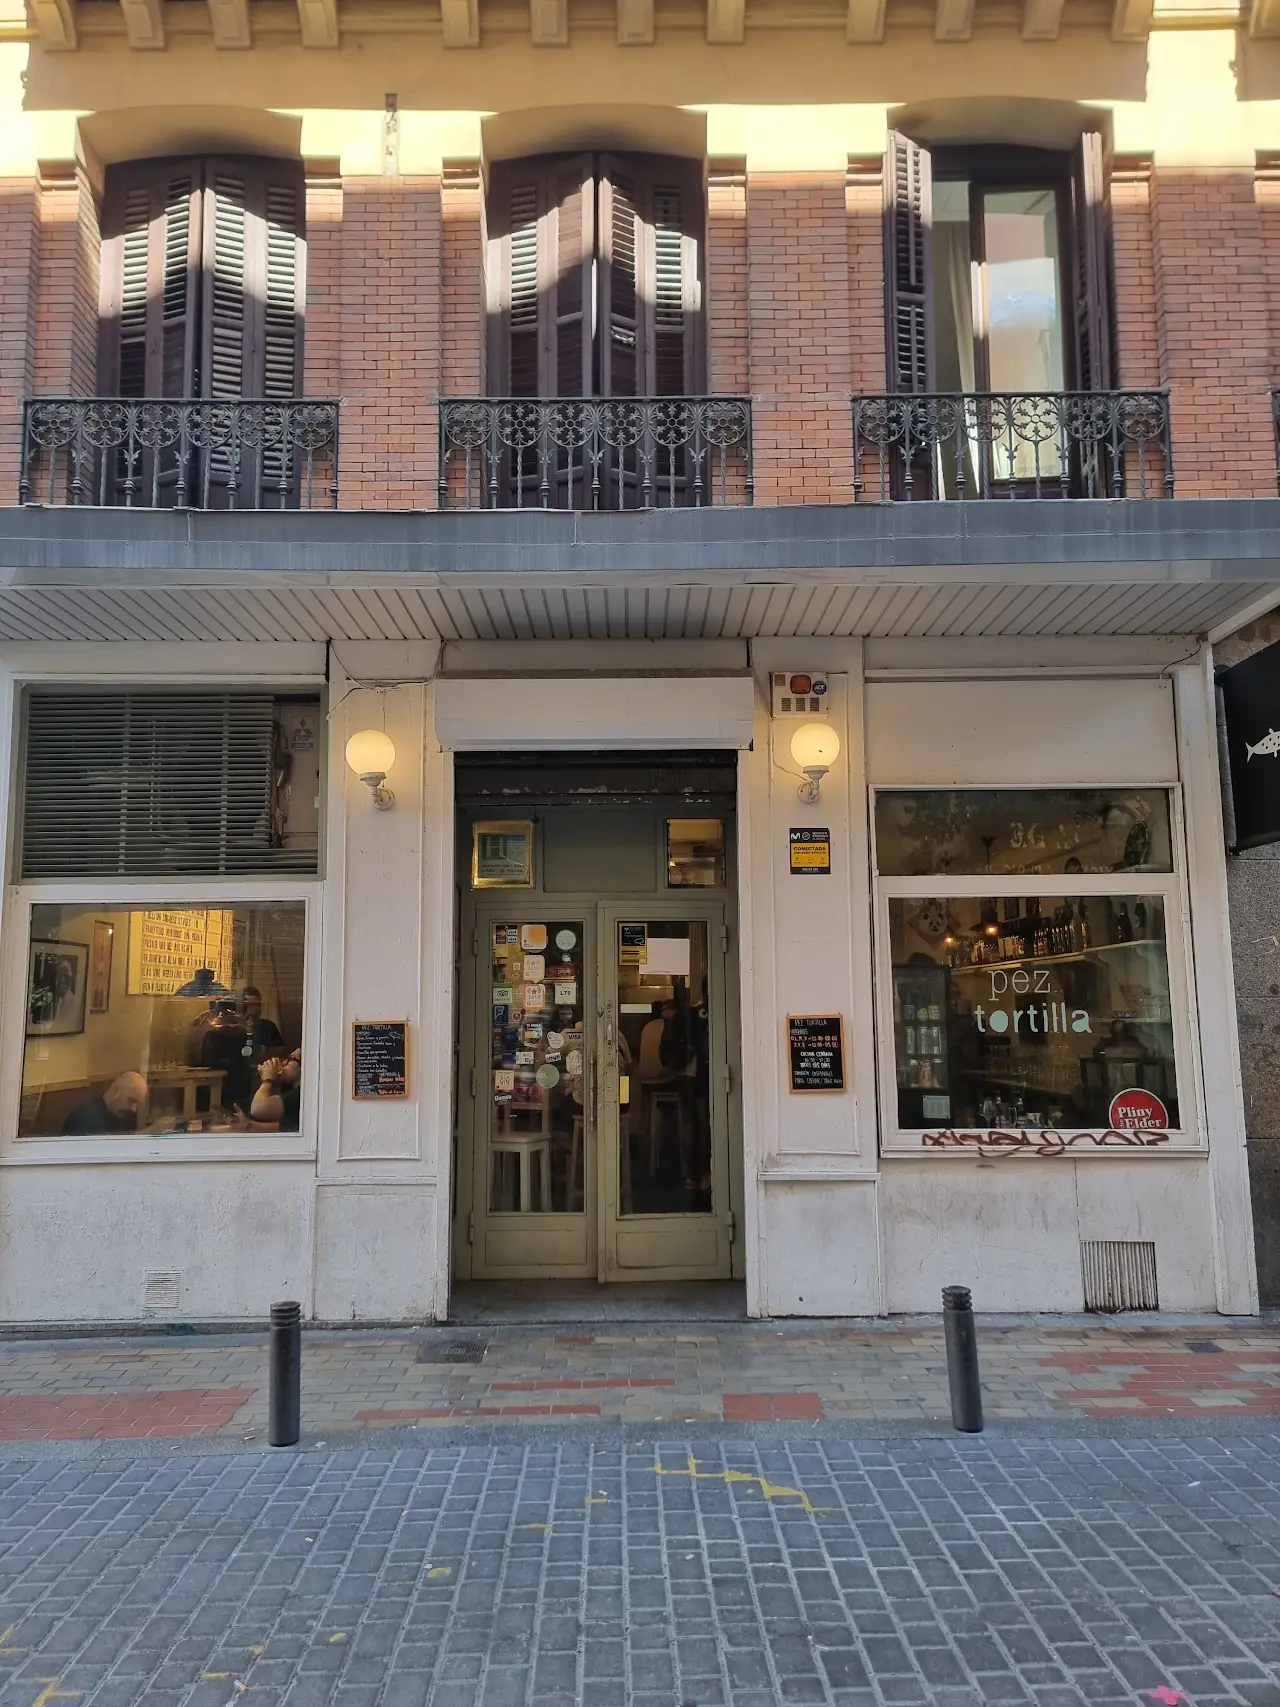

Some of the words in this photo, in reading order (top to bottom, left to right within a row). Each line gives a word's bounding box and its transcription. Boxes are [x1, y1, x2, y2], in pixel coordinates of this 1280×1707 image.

[988, 970, 1051, 1001] pez
[974, 1002, 1092, 1034] tortilla
[1118, 1107, 1152, 1118] Pliny
[1124, 1118, 1161, 1129] Elder
